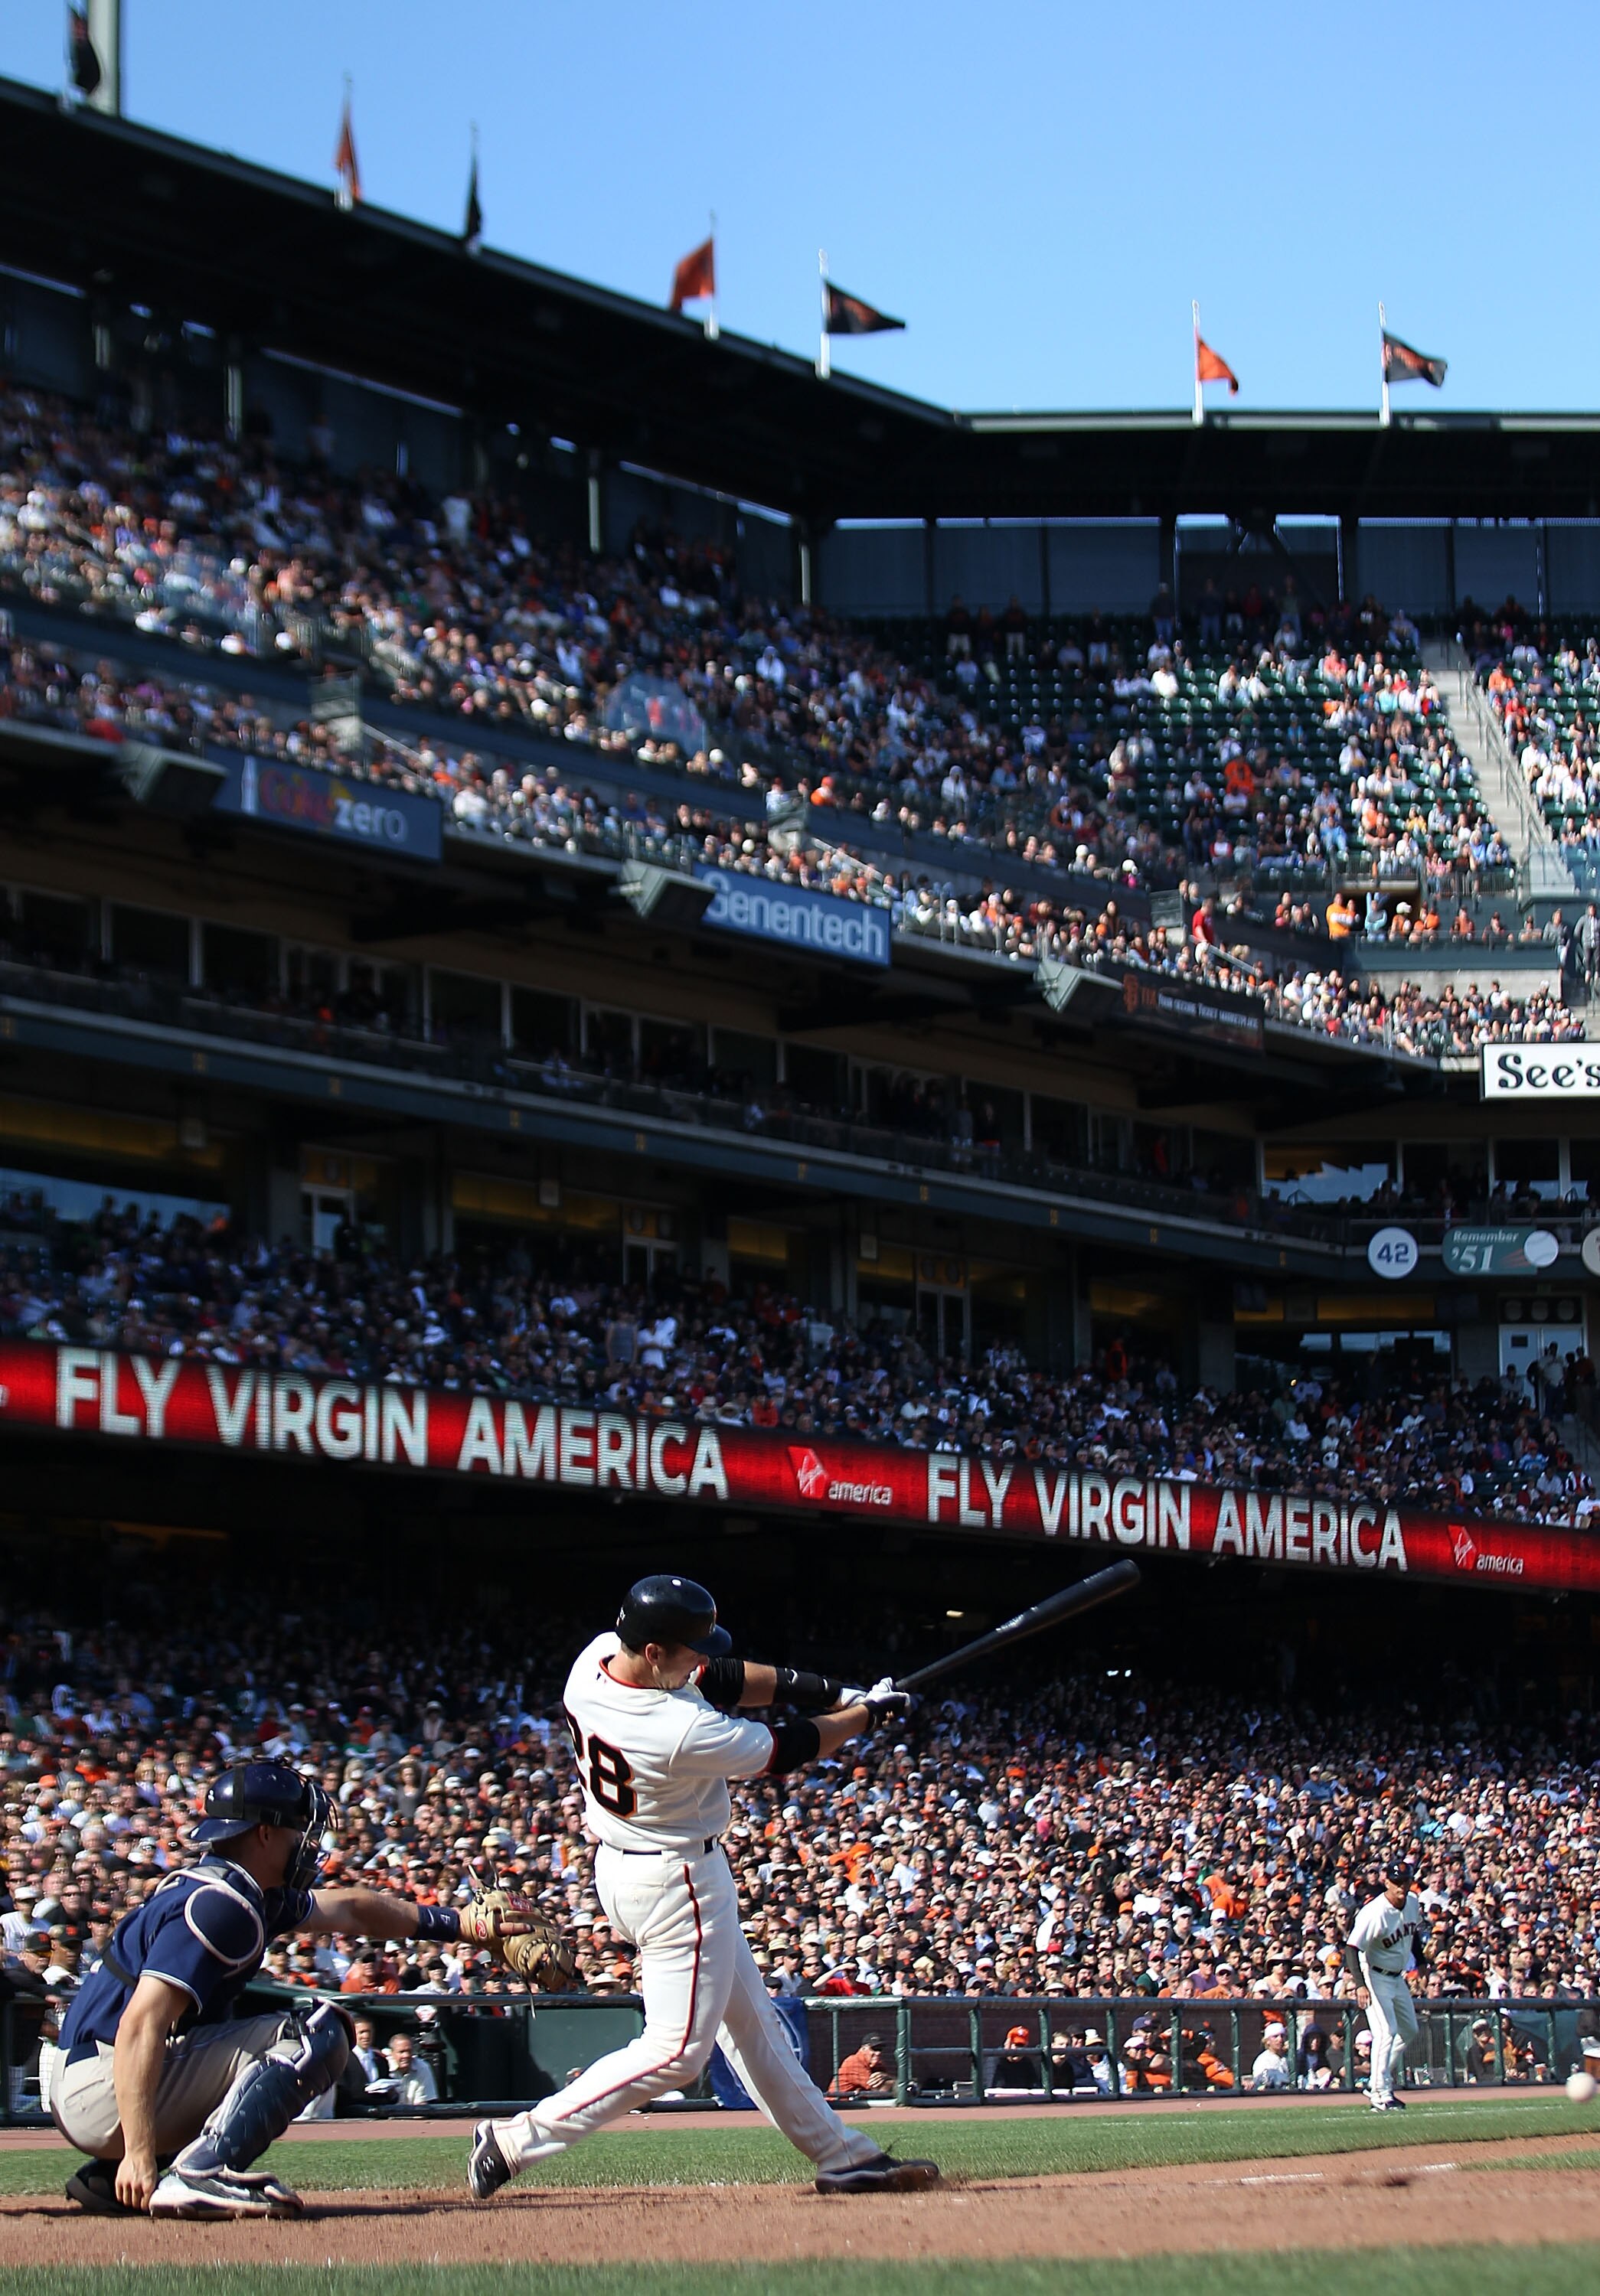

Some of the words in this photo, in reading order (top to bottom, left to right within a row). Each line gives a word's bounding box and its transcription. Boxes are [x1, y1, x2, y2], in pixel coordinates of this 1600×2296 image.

[335, 797, 407, 842] zero
[1497, 1053, 1600, 1088] See's
[1453, 1231, 1519, 1243] Remember
[1377, 1242, 1409, 1263] 42
[57, 1346, 181, 1438] FLY
[206, 1365, 427, 1466] VIRGIN
[458, 1397, 729, 1500] AMERICA
[828, 1480, 893, 1505] america
[928, 1454, 1014, 1528] FLY
[1033, 1466, 1190, 1550] VIRGIN
[1212, 1490, 1408, 1572] AMERICA
[1477, 1553, 1523, 1574] america
[1382, 1922, 1416, 1949] GIANT
